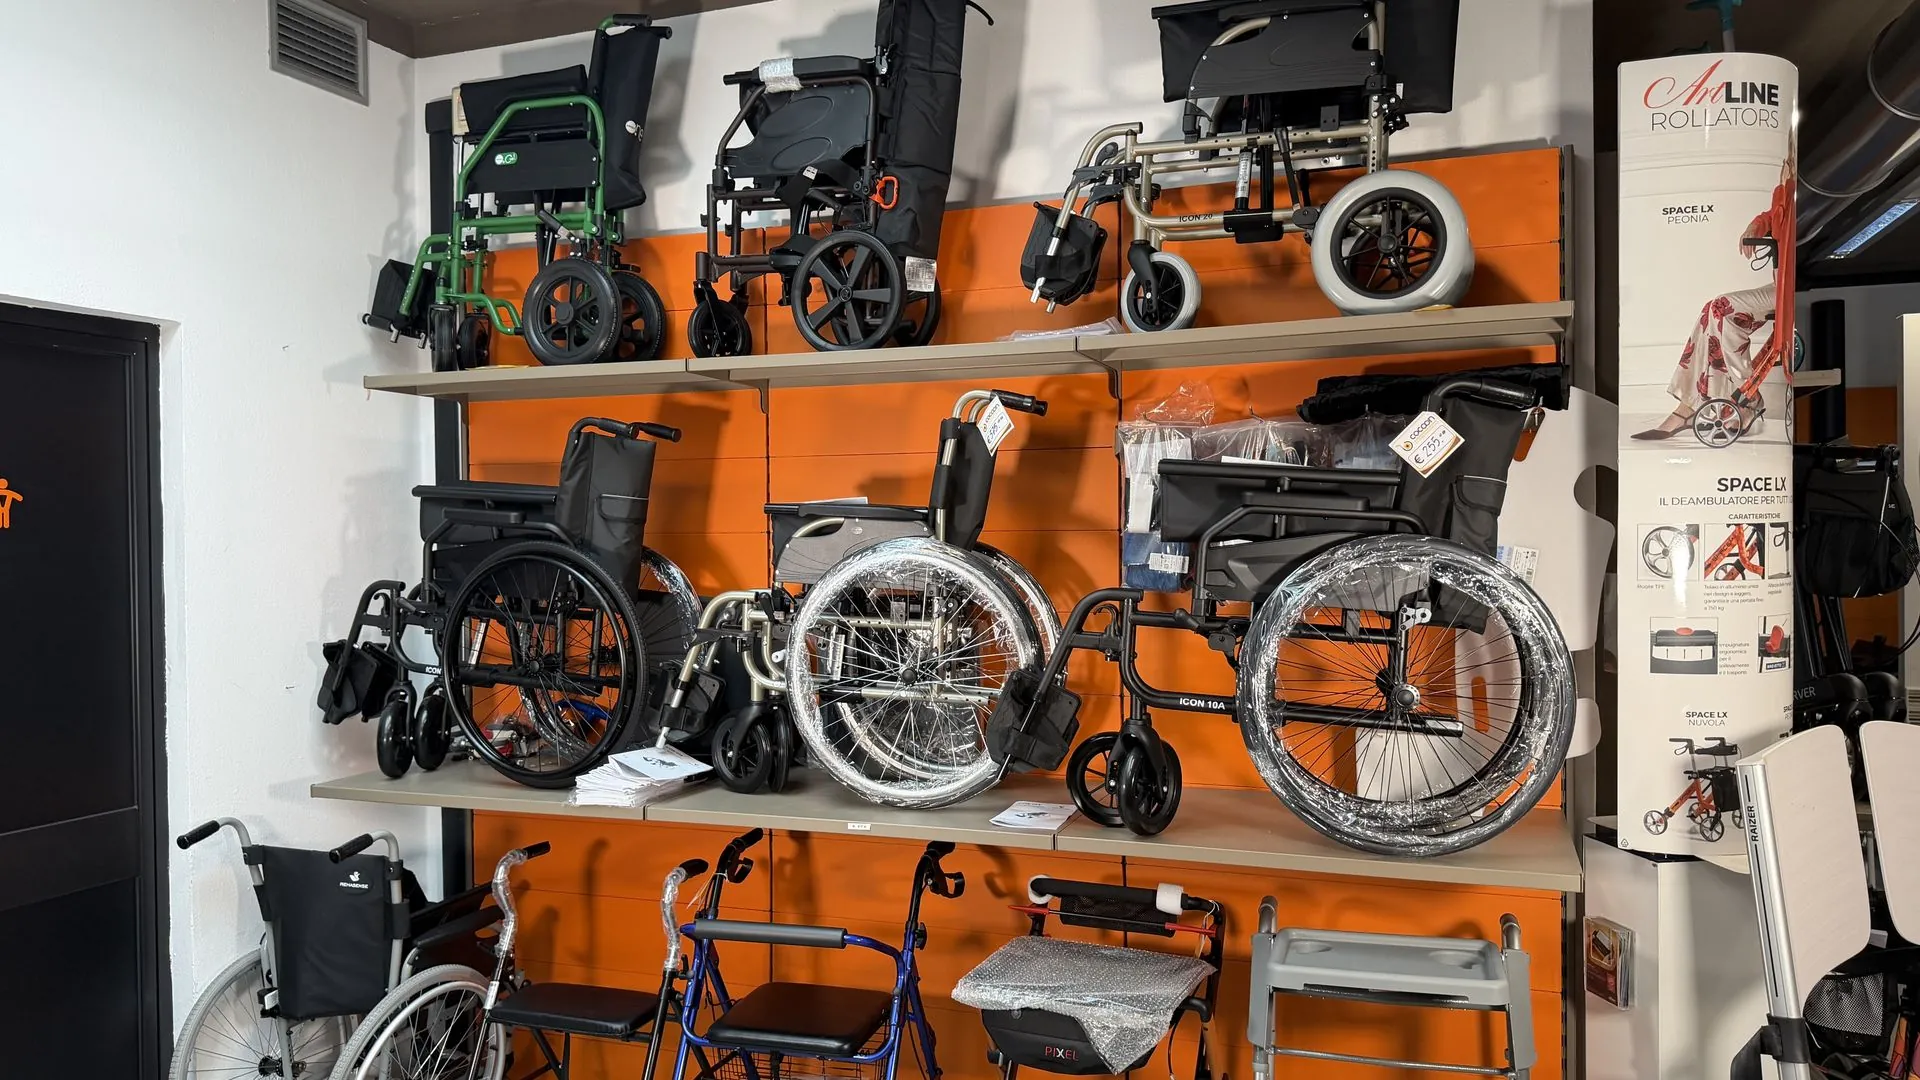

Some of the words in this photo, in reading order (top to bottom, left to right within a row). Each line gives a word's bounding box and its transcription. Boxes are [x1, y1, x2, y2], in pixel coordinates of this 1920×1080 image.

[1651, 107, 1779, 131] ROLLATORS
[1662, 205, 1698, 215] SPACE
[1700, 204, 1714, 213] LX
[1179, 214, 1201, 222] ICON
[1667, 215, 1710, 224] PEONIA
[1410, 415, 1435, 439] cocoon
[1414, 454, 1424, 463] €
[1717, 476, 1772, 492] SPACE
[1774, 476, 1787, 491] LX
[1659, 497, 1668, 506] IL
[1671, 495, 1759, 506] DEAMBULATORE
[1760, 495, 1775, 505] PER
[425, 666, 441, 674] ICON
[1179, 697, 1204, 707] ICON
[1207, 700, 1226, 710] 10A
[1688, 718, 1726, 727] NUVOLA
[1747, 805, 1760, 842] RAIZER
[1045, 1046, 1079, 1061] PIXEL
